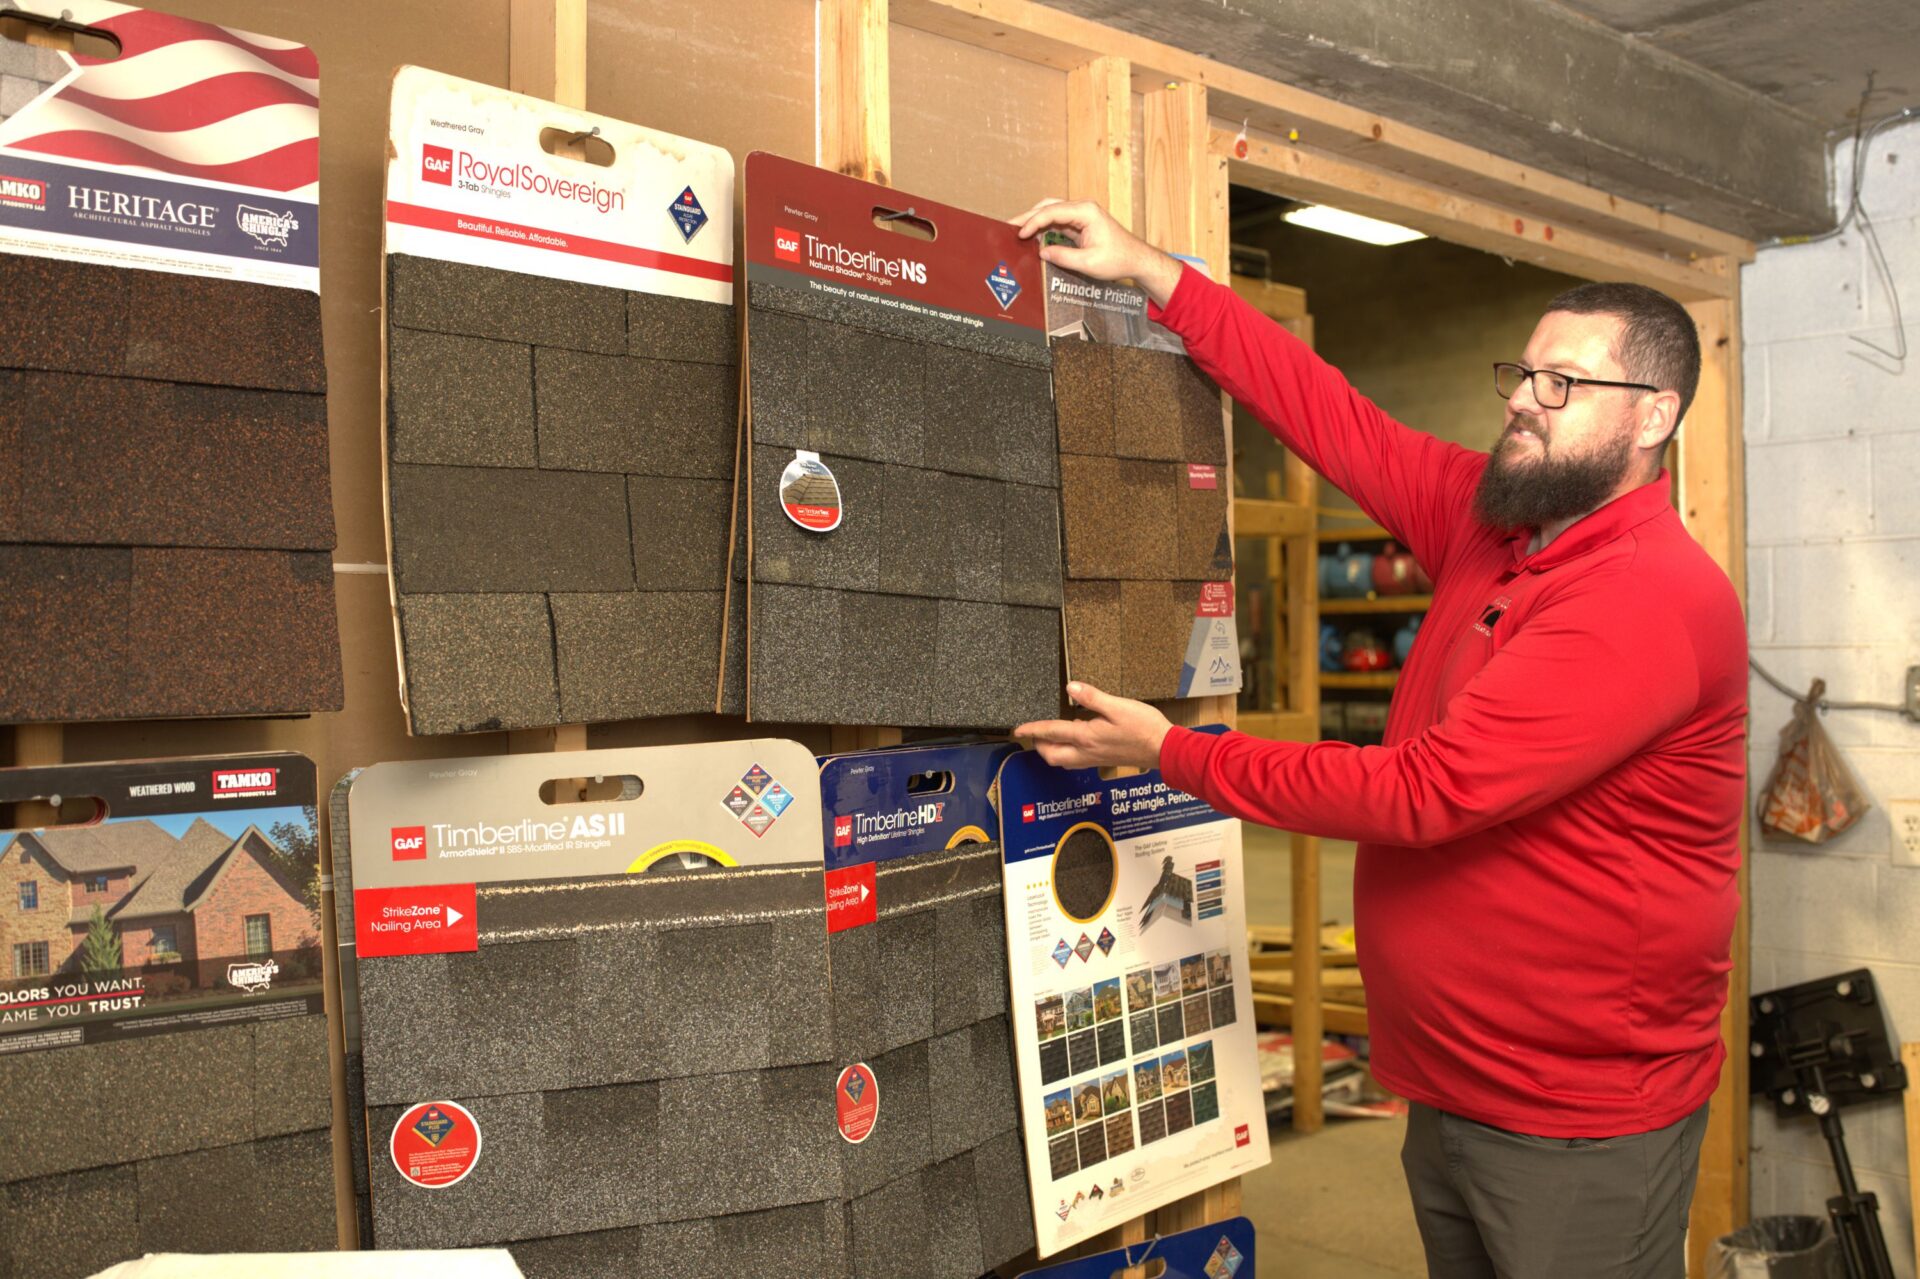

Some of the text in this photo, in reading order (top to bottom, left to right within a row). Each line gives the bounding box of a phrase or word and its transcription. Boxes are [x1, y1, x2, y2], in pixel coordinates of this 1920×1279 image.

[429, 119, 484, 135] Weathered Gray
[425, 156, 451, 172] GAF
[0, 179, 41, 200] MKO
[458, 180, 511, 198] 3-Tab Shingles
[67, 185, 216, 228] HERITAGE
[784, 205, 819, 222] Pewter Gray
[73, 211, 211, 236] ARCHITECTURAL ASPHALT SHINGLES
[242, 213, 299, 230] AMERICA'S
[242, 222, 289, 238] SHINGLE
[457, 219, 569, 248] Beautiful. Reliable. Affordable.
[777, 237, 798, 252] GAF
[809, 259, 835, 272] Natural
[866, 273, 892, 286] Shingles
[1050, 277, 1143, 306] Pinnacle Pristine
[809, 280, 822, 290] The
[823, 284, 847, 298] beauty
[848, 290, 856, 298] of
[856, 292, 880, 303] natural
[880, 298, 899, 308] wood
[900, 302, 921, 313] shakes
[939, 312, 962, 322] asphalt
[962, 317, 984, 327] shingle
[218, 772, 271, 788] TAMKO
[458, 769, 478, 778] Gray
[129, 781, 195, 798] WEATHERED WOOD
[1110, 788, 1127, 800] The
[1129, 782, 1152, 797] most
[1023, 809, 1035, 818] GAF
[1111, 801, 1131, 815] GAF
[1132, 796, 1168, 812] shingle.
[432, 821, 566, 848] Timberline
[569, 813, 605, 839] AS
[835, 824, 851, 837] GAF
[857, 835, 867, 845] High
[907, 827, 925, 837] Shingles
[394, 837, 423, 850] GAF
[507, 841, 564, 854] SBS-Modified
[565, 840, 574, 850] IR
[575, 839, 611, 851] Shingles
[829, 884, 859, 898] StrikeZone
[382, 905, 440, 918] StrikeZone
[826, 897, 859, 911] ailing Area
[371, 919, 441, 933] Nailing Area
[232, 965, 279, 978] AMERICA'S
[54, 983, 89, 997] YOU
[94, 976, 146, 994] WANT.
[232, 975, 271, 986] SHINGLE
[47, 1004, 81, 1018] YOU
[88, 996, 146, 1013] TRUST.
